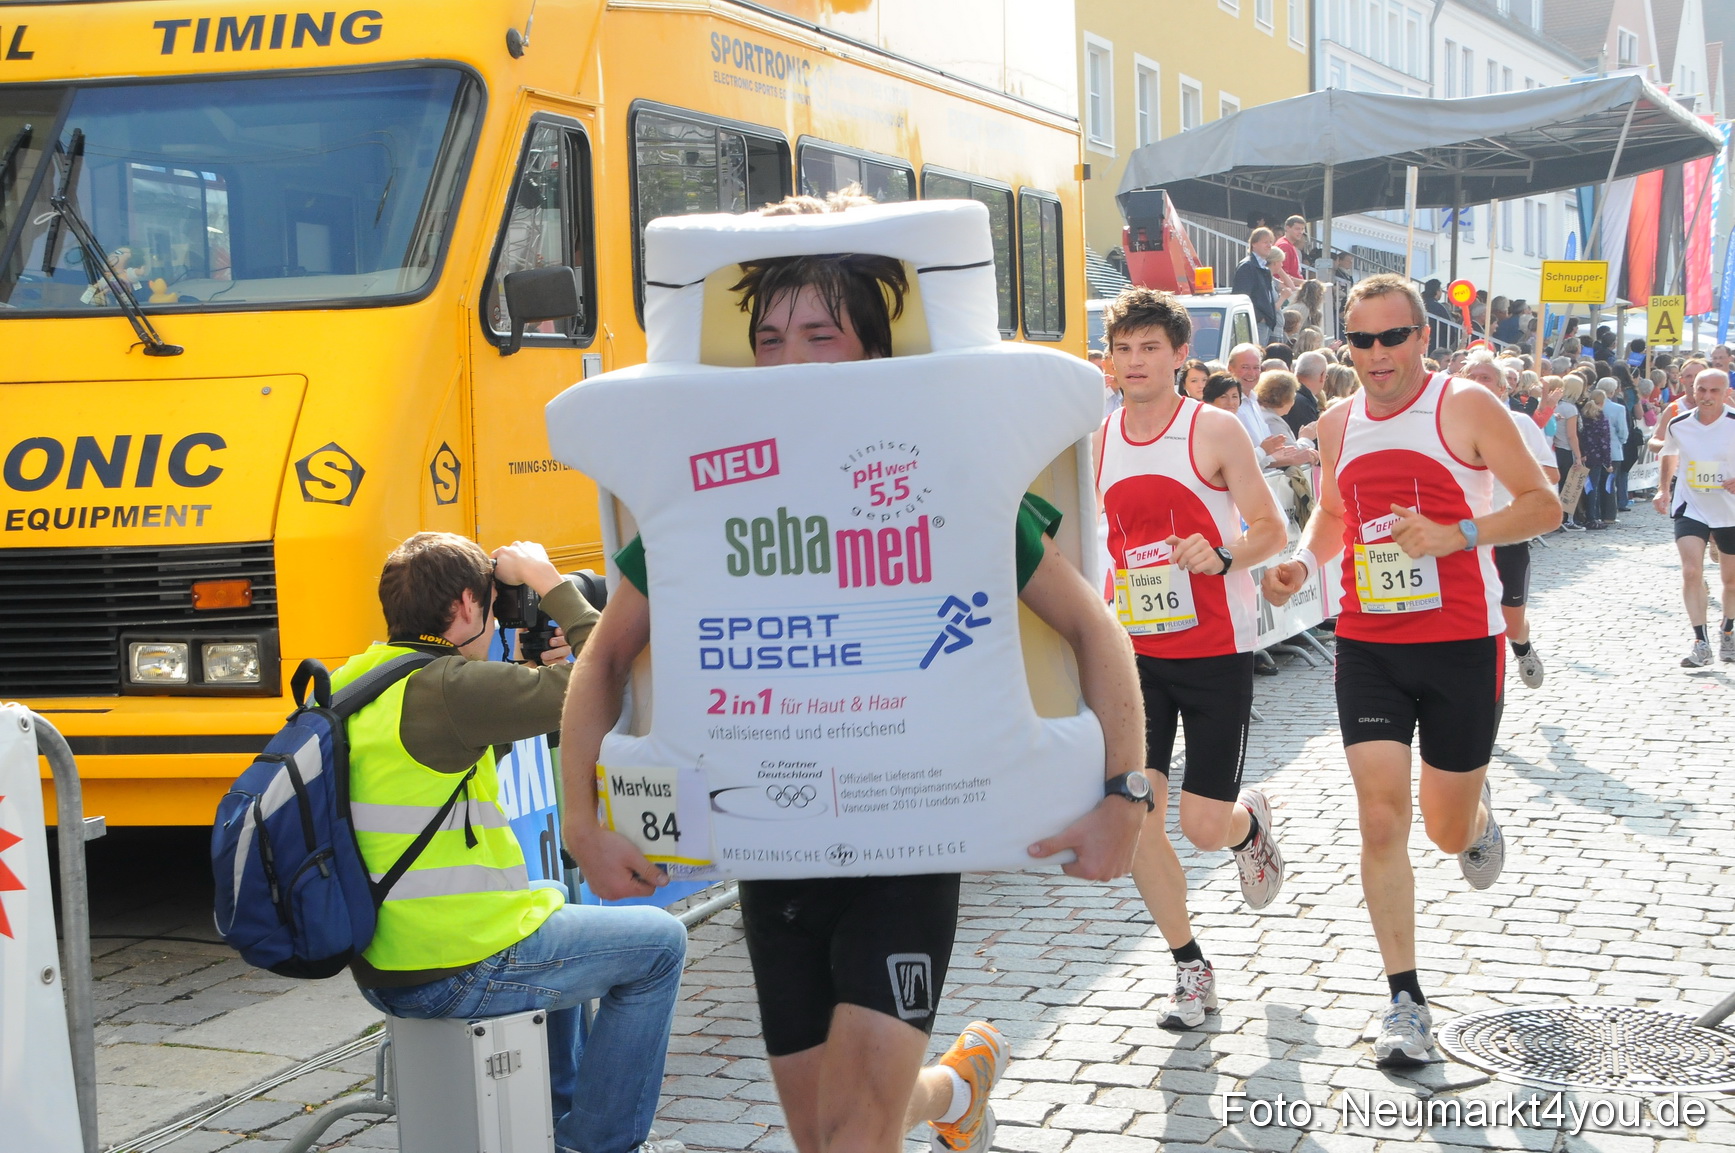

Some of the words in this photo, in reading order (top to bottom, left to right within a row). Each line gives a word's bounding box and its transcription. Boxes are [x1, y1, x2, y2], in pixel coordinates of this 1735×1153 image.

[0, 25, 35, 61] L
[153, 9, 384, 56] TIMING
[710, 31, 811, 88] SPORTRONIC
[713, 70, 753, 92] ELECTRONIC
[754, 82, 778, 98] SPORTS
[1545, 272, 1603, 283] Schnupper-
[1564, 284, 1583, 293] lauf
[1651, 297, 1680, 307] Block
[1654, 310, 1675, 335] A
[3, 432, 228, 492] ONIC
[695, 444, 773, 487] NEU
[840, 440, 921, 473] klinisch
[853, 461, 882, 489] pH
[885, 459, 918, 477] Wert
[1696, 473, 1723, 483] 1013
[869, 476, 910, 507] 5,5
[851, 486, 932, 523] geprüft
[5, 504, 212, 532] EQUIPMENT
[1136, 547, 1160, 562] DEHN
[1369, 550, 1400, 564] Peter
[1130, 574, 1162, 588] Tobias
[1380, 568, 1423, 591] 315
[1140, 591, 1180, 612] 316
[1405, 596, 1439, 607] PFLEIDERER
[698, 614, 840, 641] SPORT
[700, 642, 863, 670] DUSCHE
[780, 696, 802, 716] für
[807, 697, 846, 715] Haut
[850, 696, 863, 711] &
[868, 693, 907, 711] Haar
[708, 725, 790, 741] vitalisierend
[796, 722, 822, 740] und
[827, 719, 906, 738] erfrischend
[757, 770, 823, 780] Deutschland
[760, 760, 776, 769] Co
[777, 760, 818, 769] Partner
[839, 772, 883, 785] Offizieller
[885, 769, 924, 782] Lieferant
[926, 767, 943, 779] der
[611, 775, 672, 798] Markus
[840, 786, 888, 799] deutschen
[890, 777, 991, 798] Olympiamannschaften
[842, 801, 890, 814] Vancouver
[892, 799, 918, 811] 2010
[925, 795, 960, 808] London
[962, 791, 987, 804] 2012
[641, 811, 681, 842] 84
[723, 847, 822, 863] MEDIZINISCHE
[863, 841, 967, 861] HAUTPFLEGE
